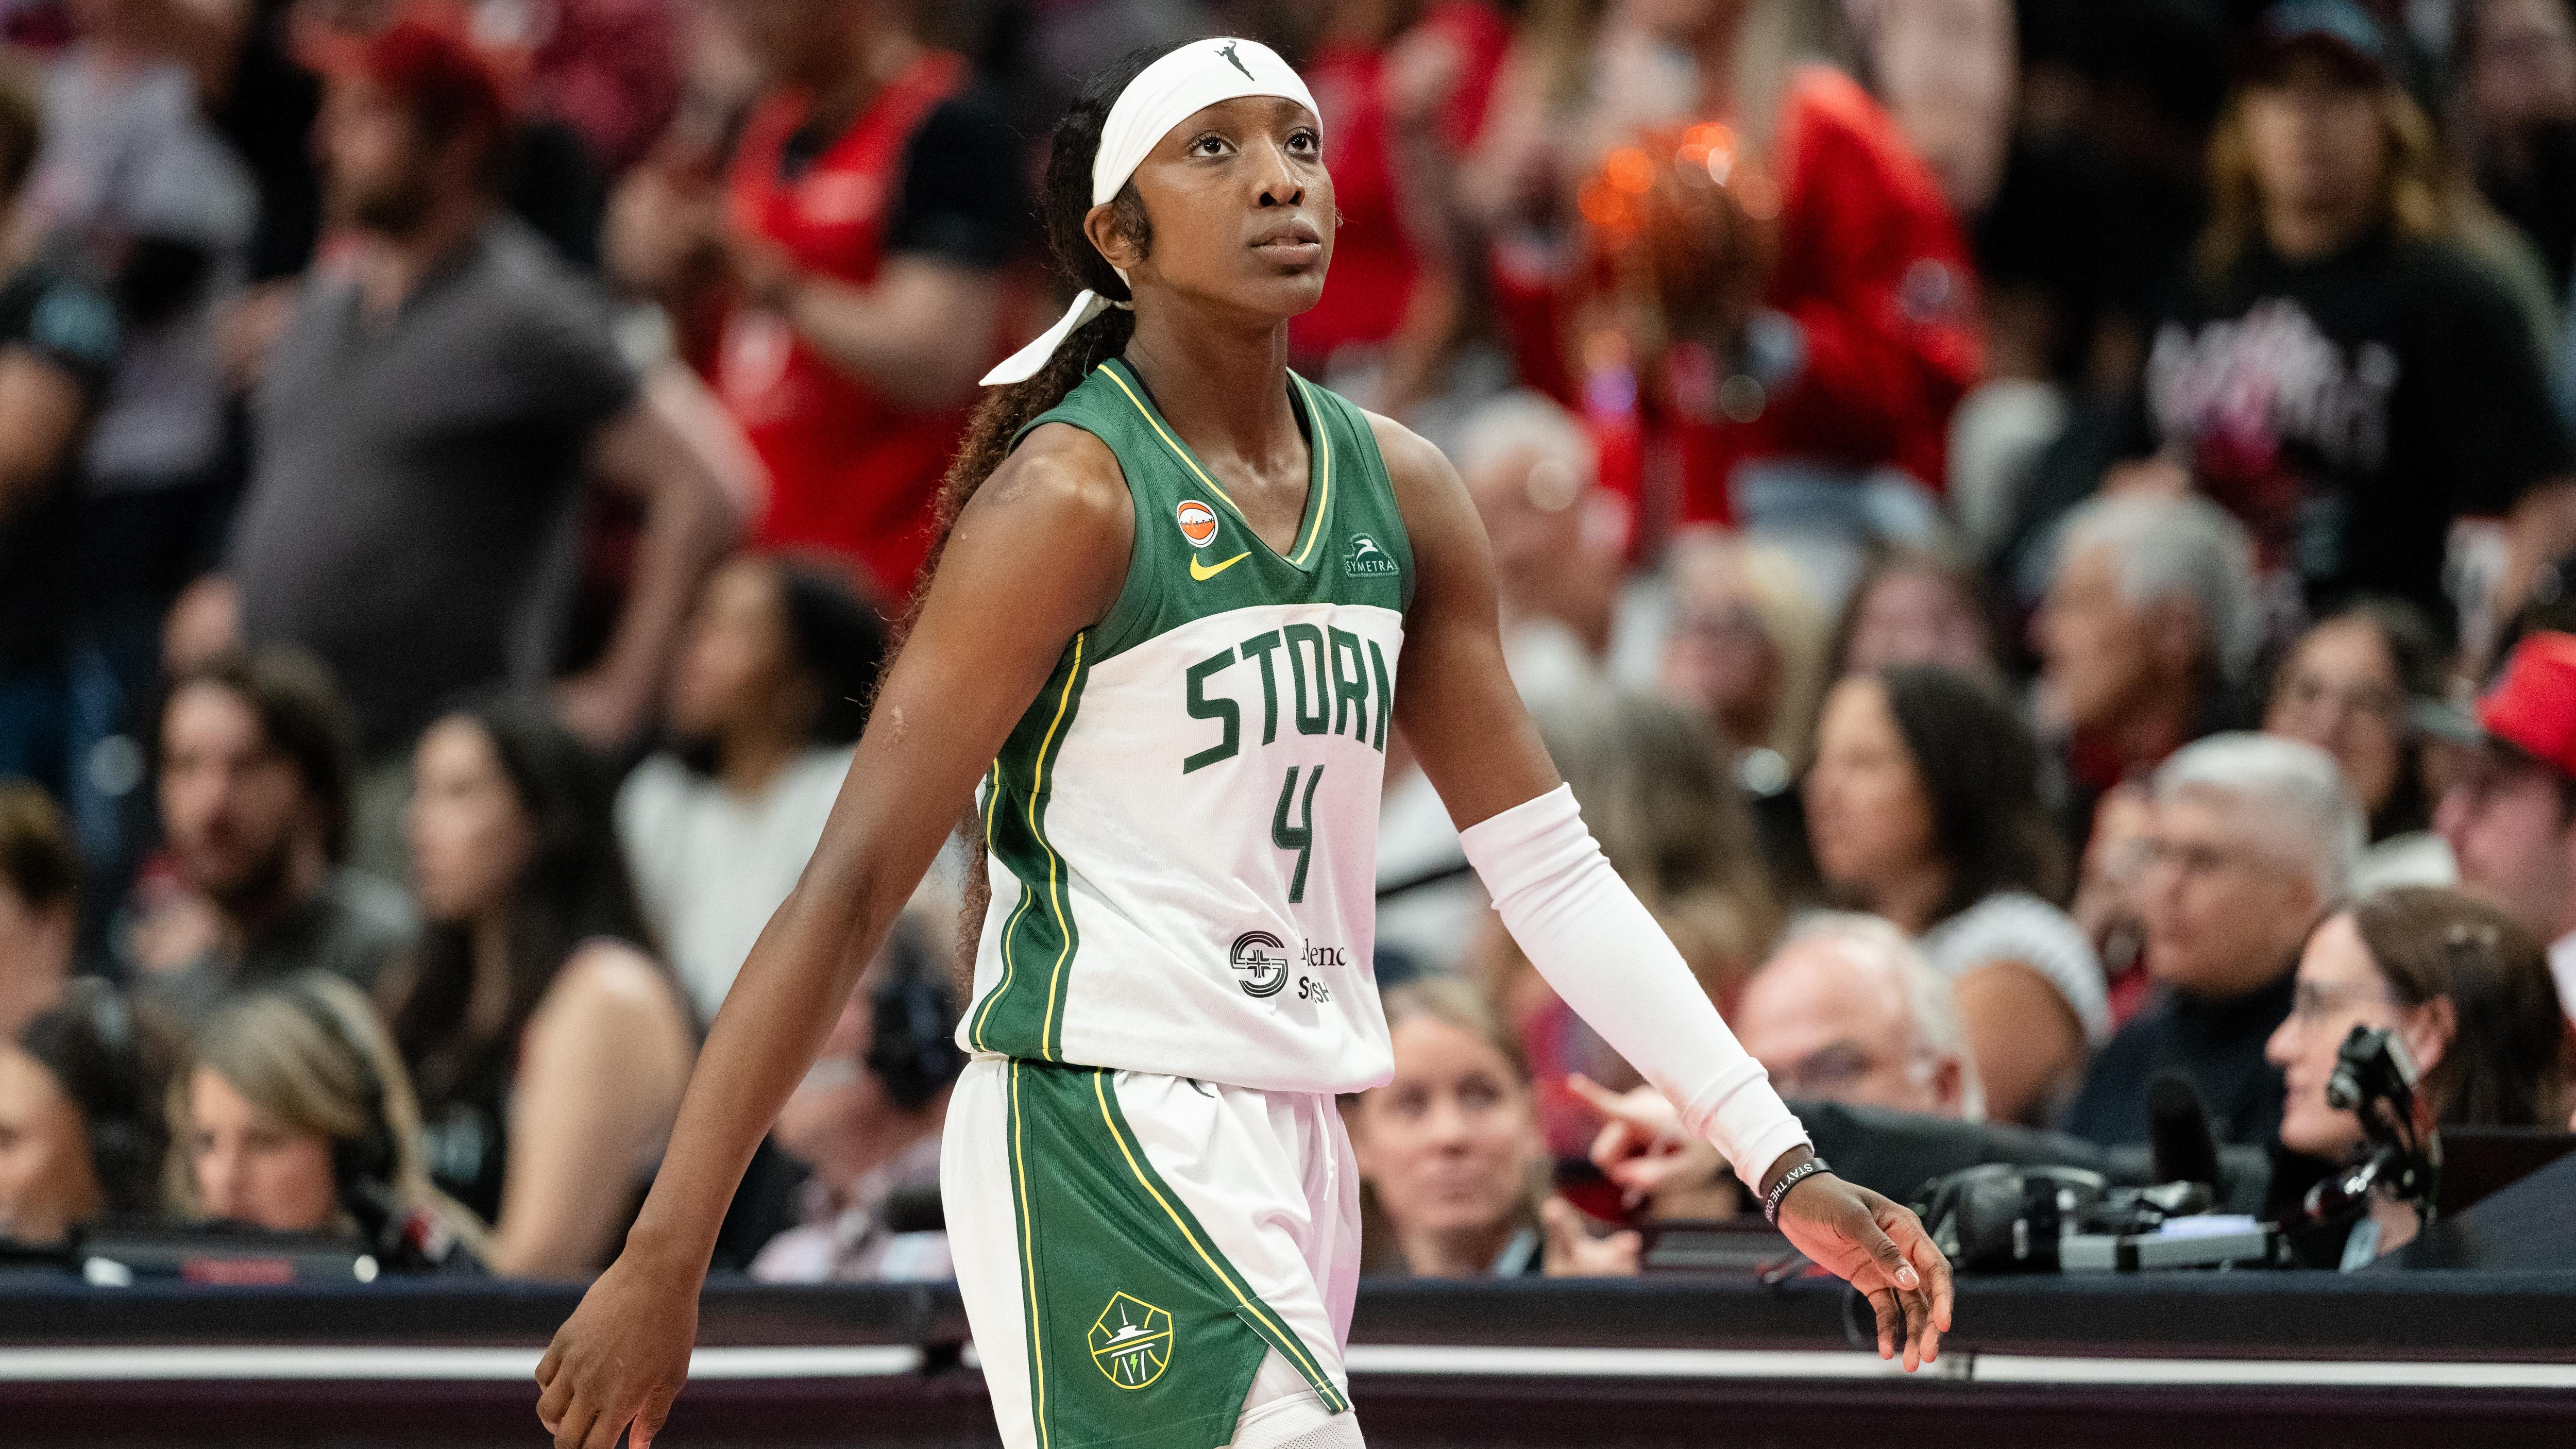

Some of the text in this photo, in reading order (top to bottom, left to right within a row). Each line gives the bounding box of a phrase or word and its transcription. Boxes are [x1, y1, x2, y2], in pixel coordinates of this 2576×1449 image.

[1346, 560, 1394, 572] SYMETRA
[1272, 764, 1325, 903] 4
[1786, 1163, 1813, 1184] STAY
[1770, 1181, 1787, 1202] THE
